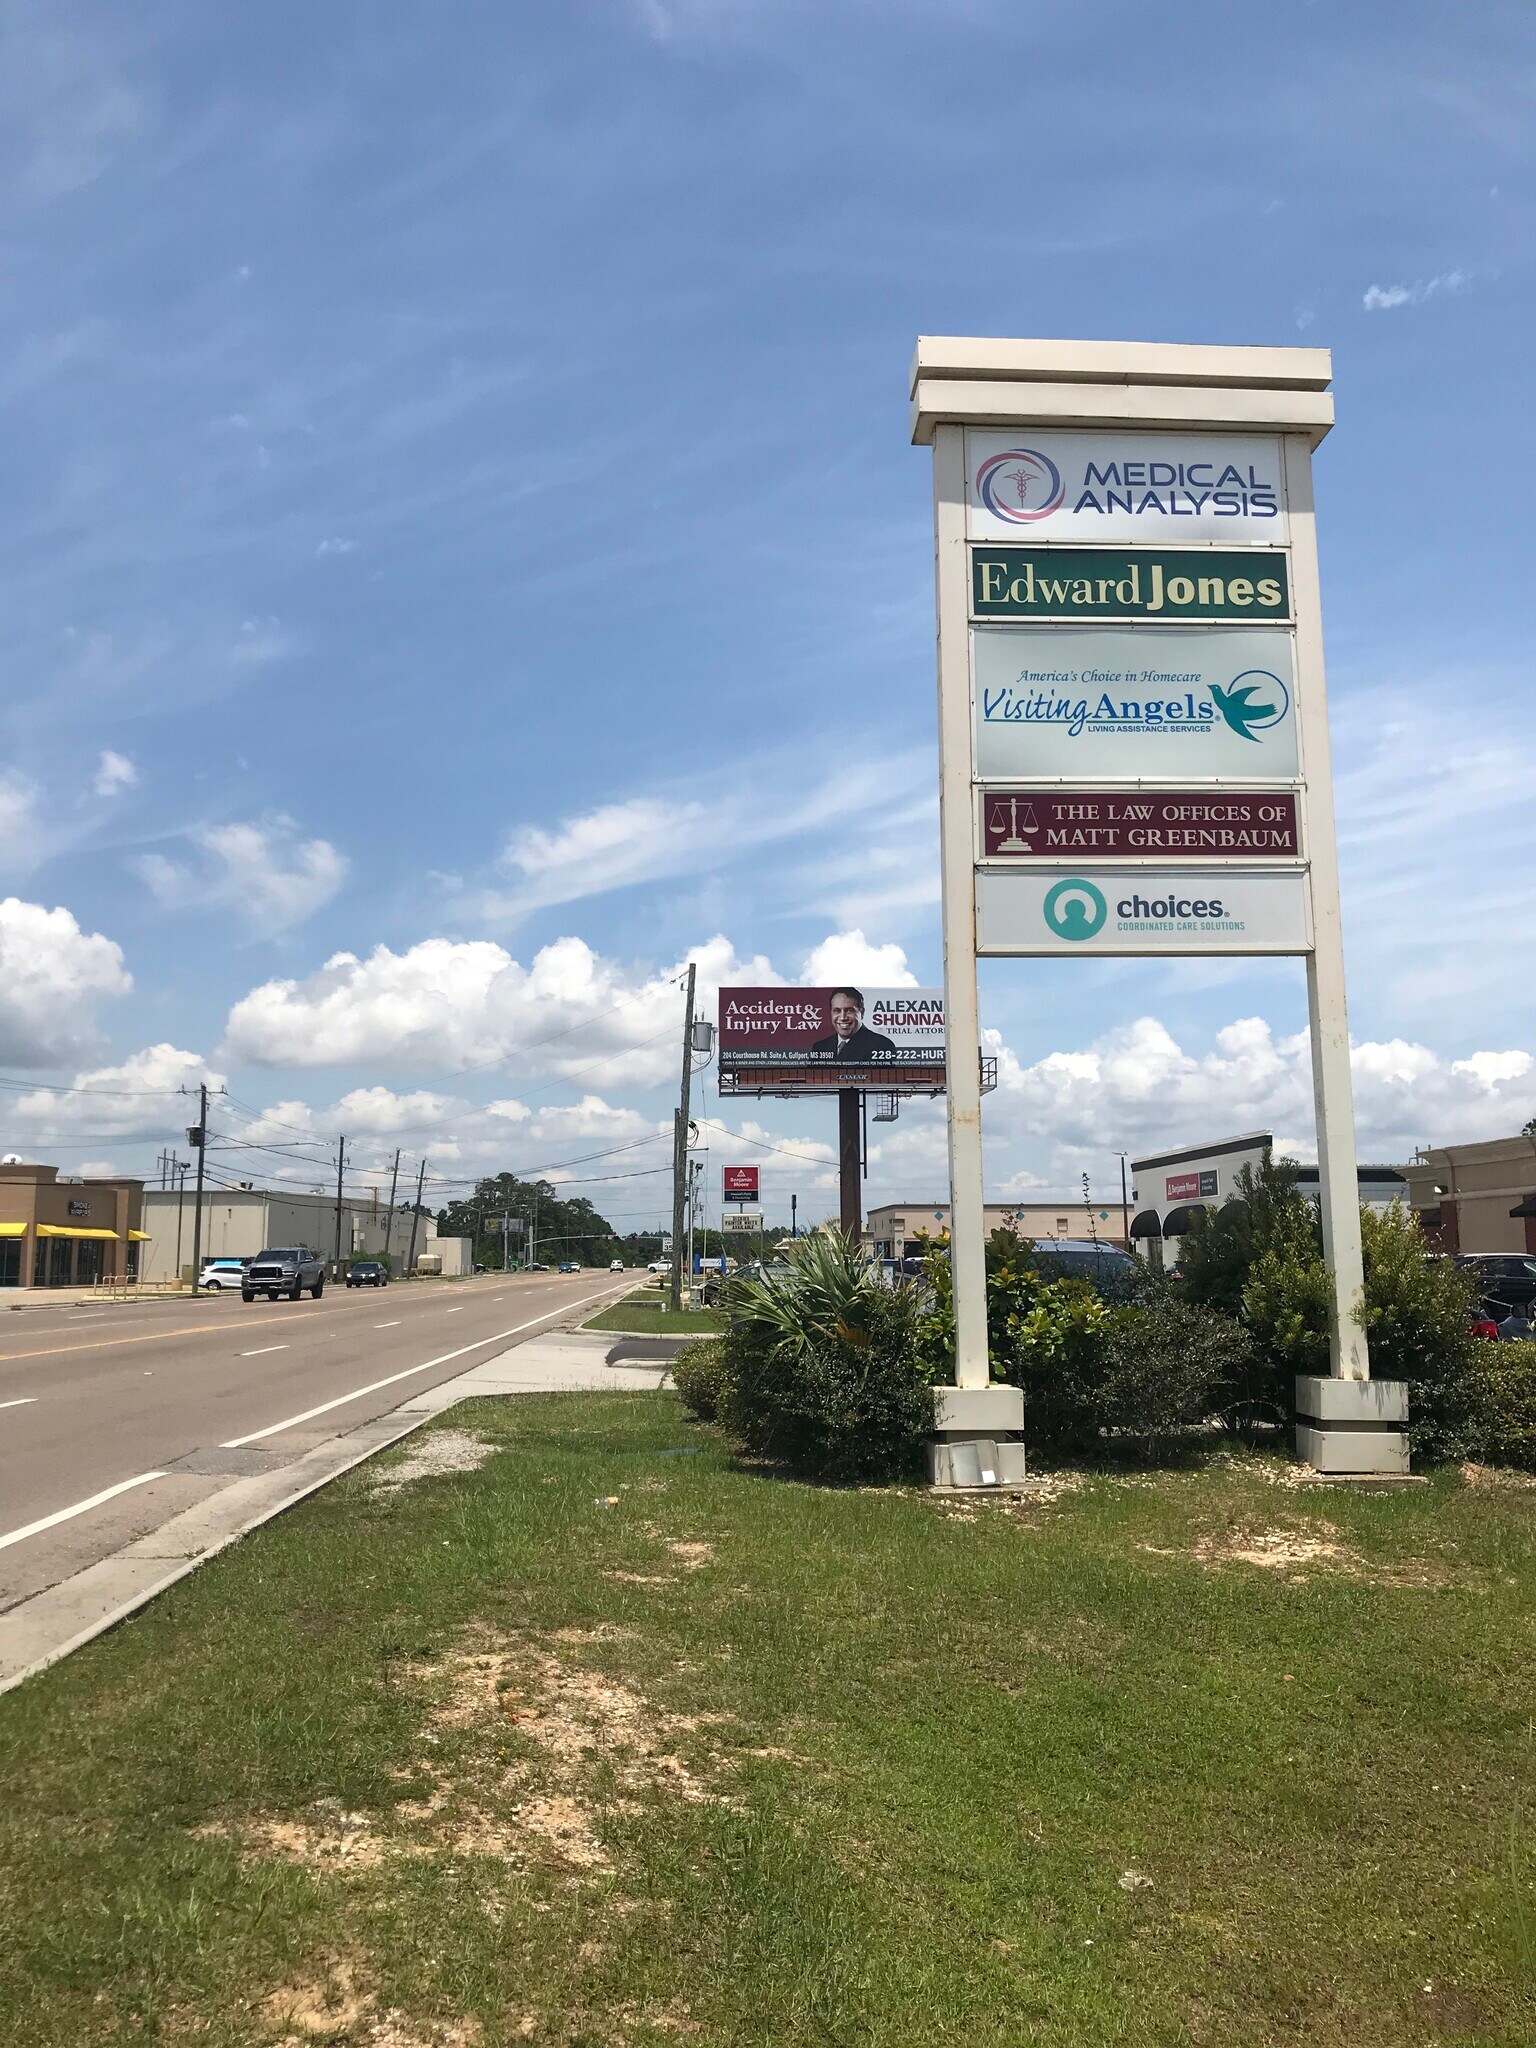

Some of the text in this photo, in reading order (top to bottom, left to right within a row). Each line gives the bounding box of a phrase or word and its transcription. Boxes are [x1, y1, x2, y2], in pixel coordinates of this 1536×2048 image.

[1083, 461, 1272, 490] MEDICAL
[1072, 489, 1278, 518] ANALYSIS
[976, 562, 1282, 611] Edward Jones
[1016, 669, 1201, 683] America's Choice in Homecare
[983, 688, 1214, 736] Visiting Angels
[1088, 725, 1211, 733] LIVING ASSISTANCE SERVICES
[1051, 804, 1287, 822] THE LAW OFFICES OF
[1046, 828, 1293, 847] MATT GREENBAUM
[1116, 894, 1224, 918] choices
[1117, 921, 1245, 931] COORDINATED CARE SOLUTIONS
[872, 1000, 945, 1013] ALEXAN
[725, 1015, 823, 1035] Injury Law
[872, 1013, 946, 1026] SHUNNA
[886, 1027, 946, 1035] TRIAL ATTOR
[722, 1051, 732, 1059] 204
[732, 1051, 760, 1059] Courthouse
[769, 1051, 781, 1059] Suite
[810, 1051, 819, 1059] MS
[819, 1051, 834, 1059] 39507
